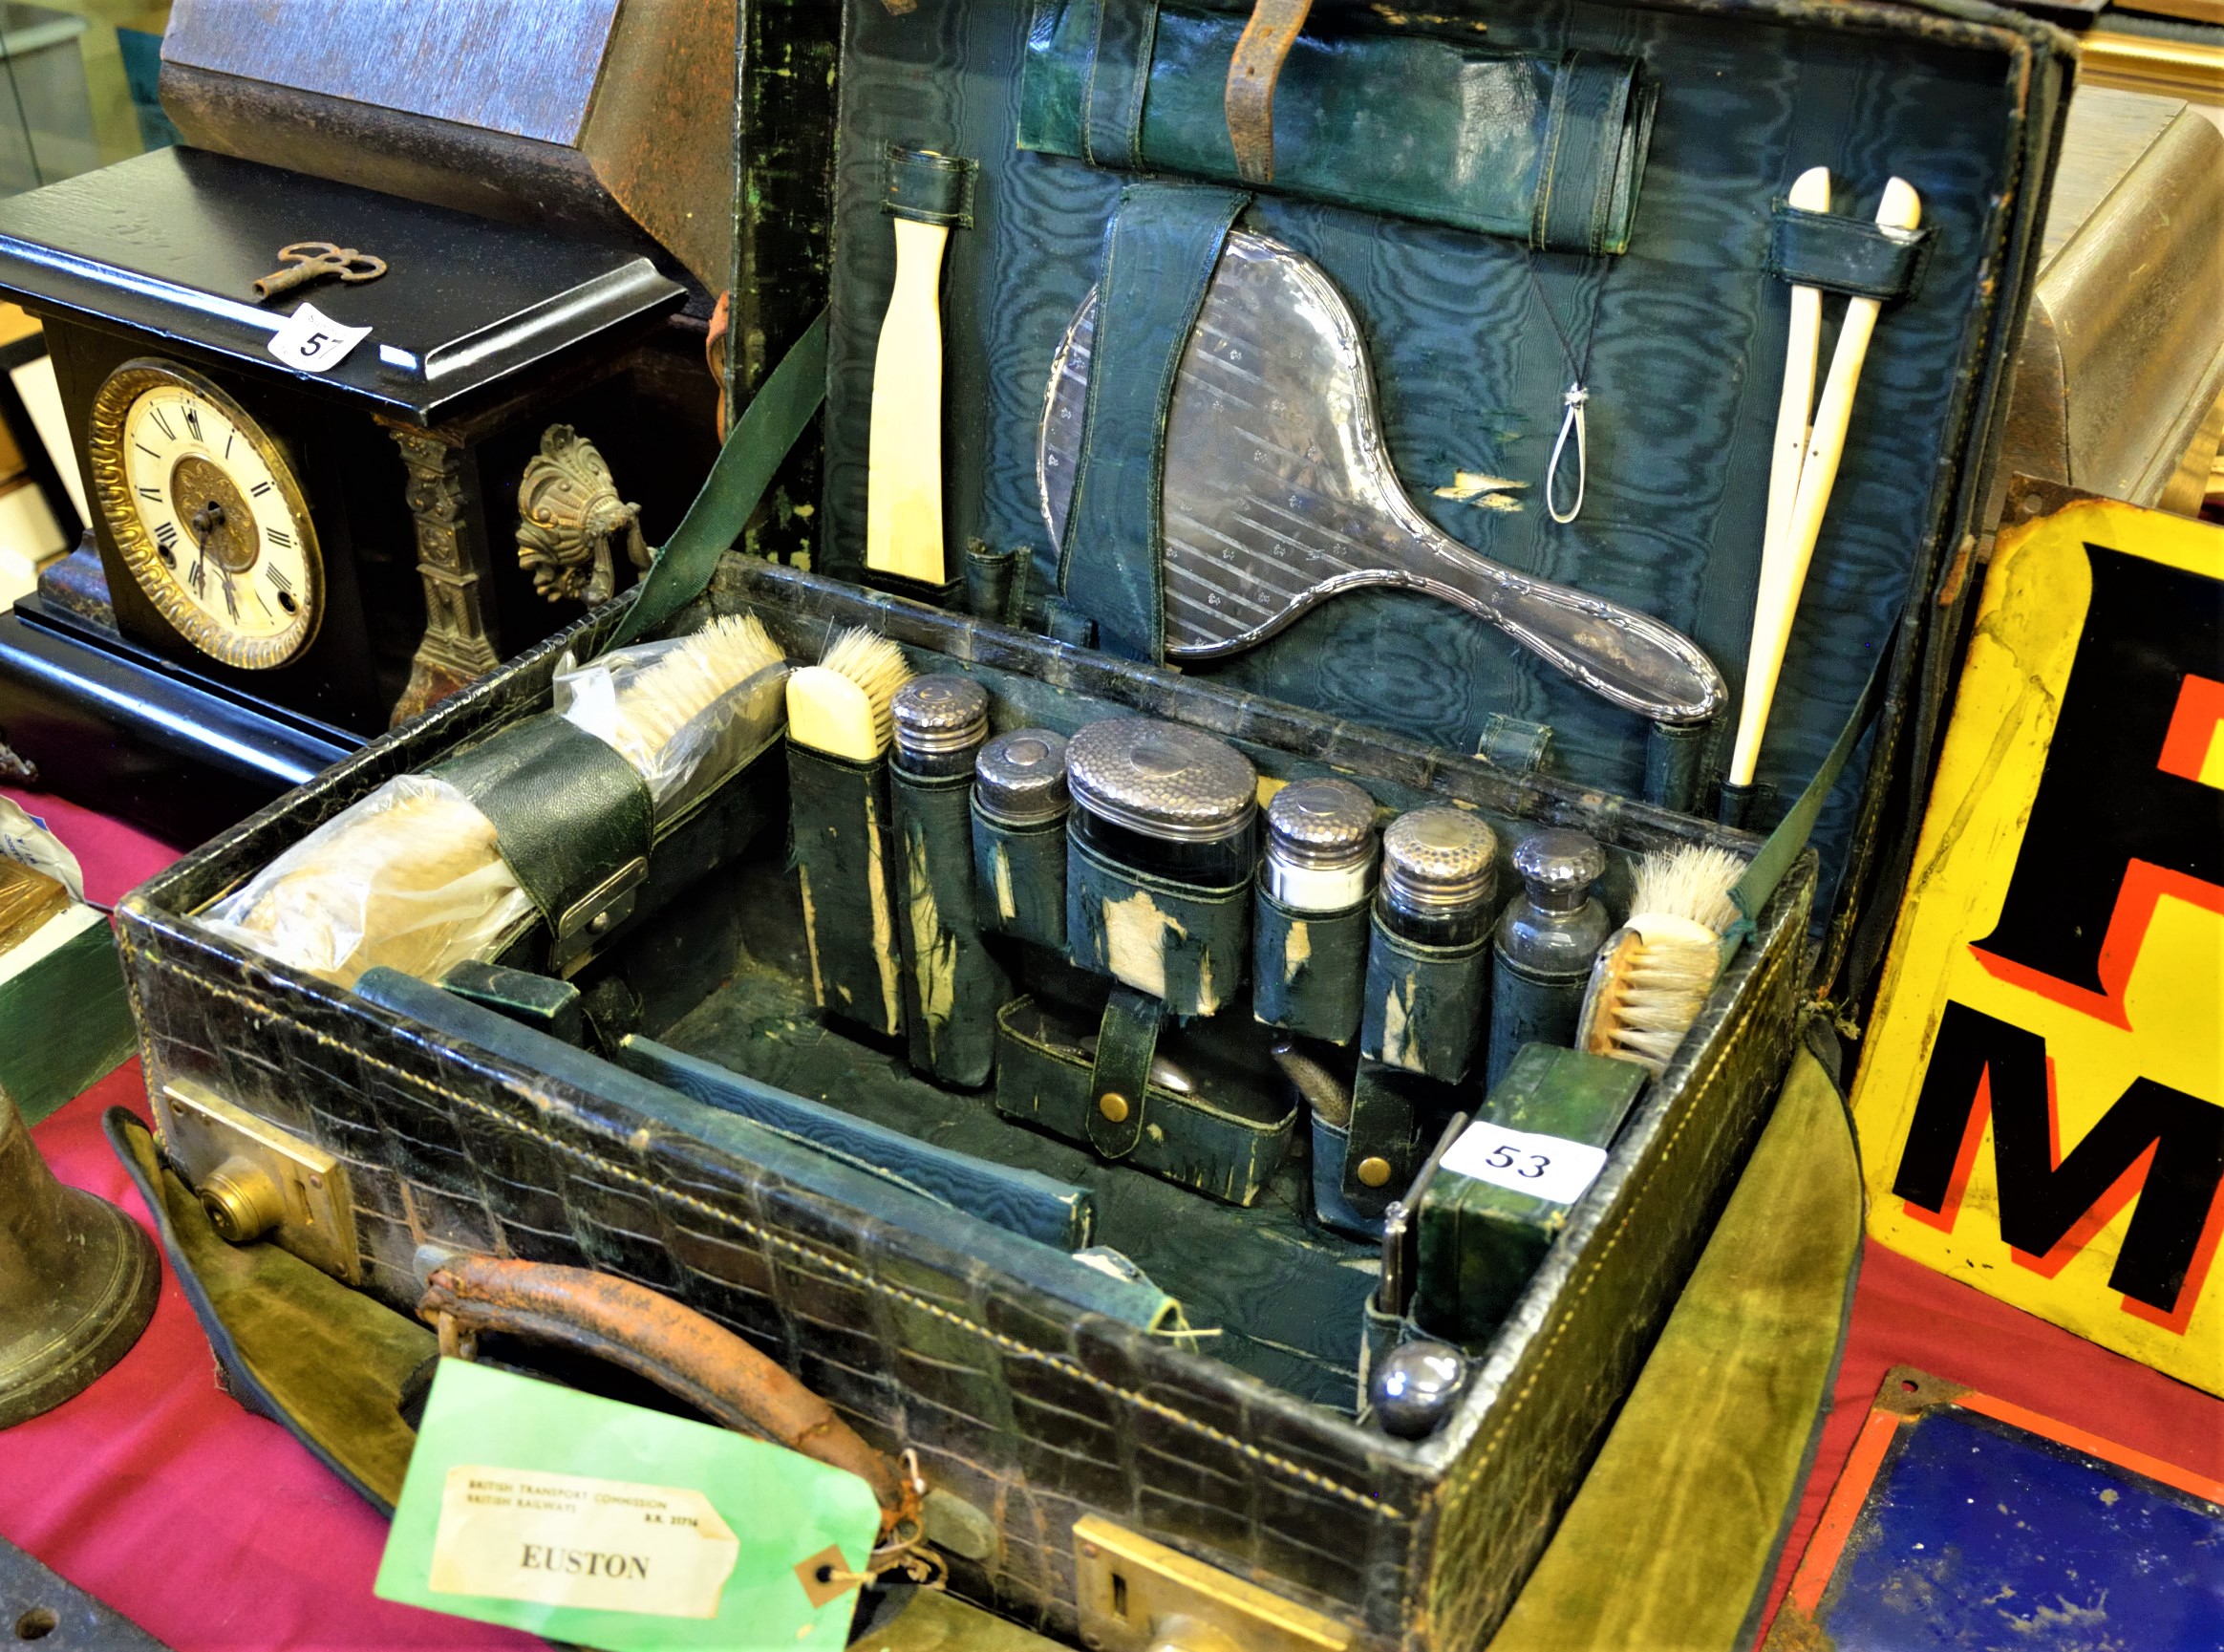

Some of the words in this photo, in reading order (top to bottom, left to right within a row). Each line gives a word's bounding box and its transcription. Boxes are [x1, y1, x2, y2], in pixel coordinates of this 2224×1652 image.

[1486, 1145, 1551, 1179] 53
[466, 1493, 512, 1507] BRITISH
[517, 1498, 577, 1514] RAILWAYS
[468, 1479, 513, 1493] BRITISH
[519, 1484, 588, 1501] TRANSPORT
[593, 1493, 668, 1511] COMMISSION
[520, 1542, 651, 1581] EUSTON
